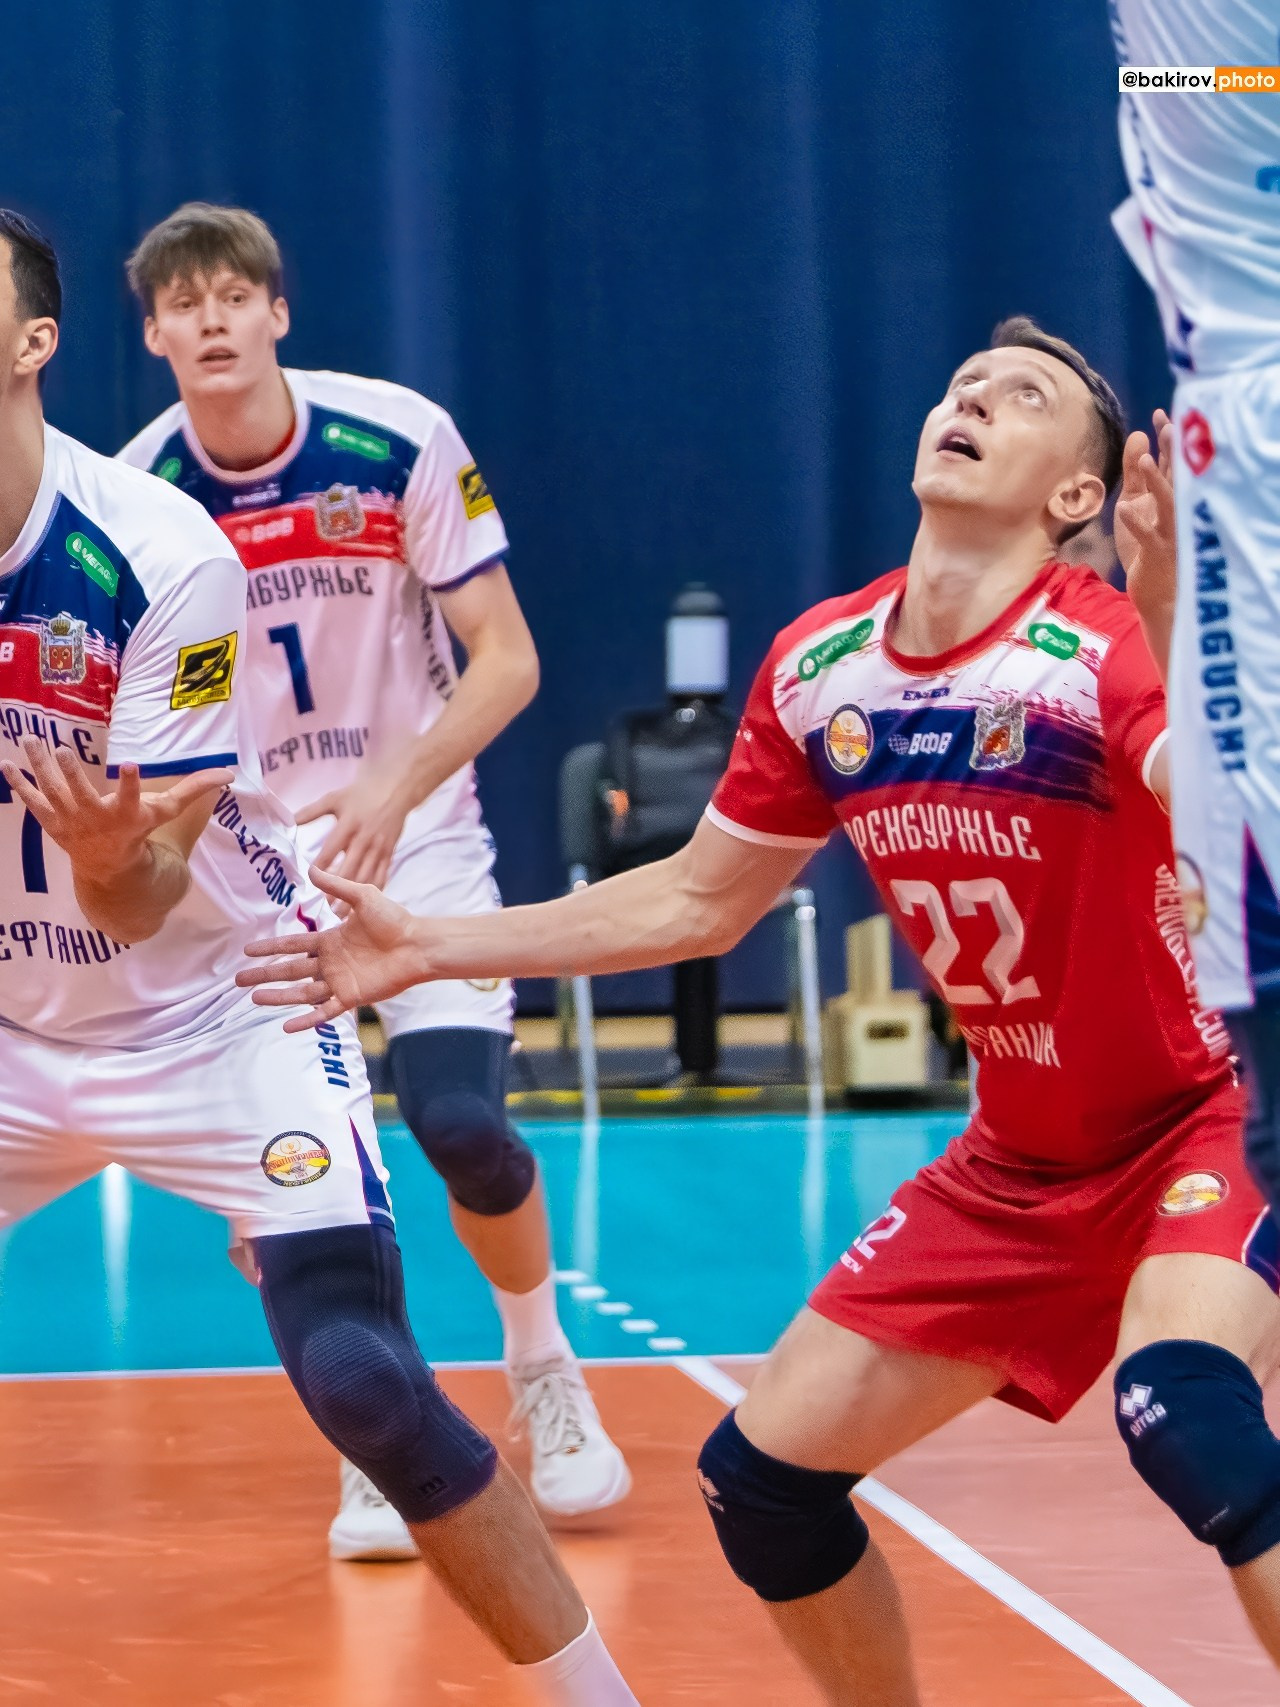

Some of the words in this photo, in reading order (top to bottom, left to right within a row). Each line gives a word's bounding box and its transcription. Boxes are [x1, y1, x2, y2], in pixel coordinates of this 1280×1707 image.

[268, 621, 315, 715] 1
[888, 876, 1042, 1006] 22
[853, 1199, 907, 1260] 2
